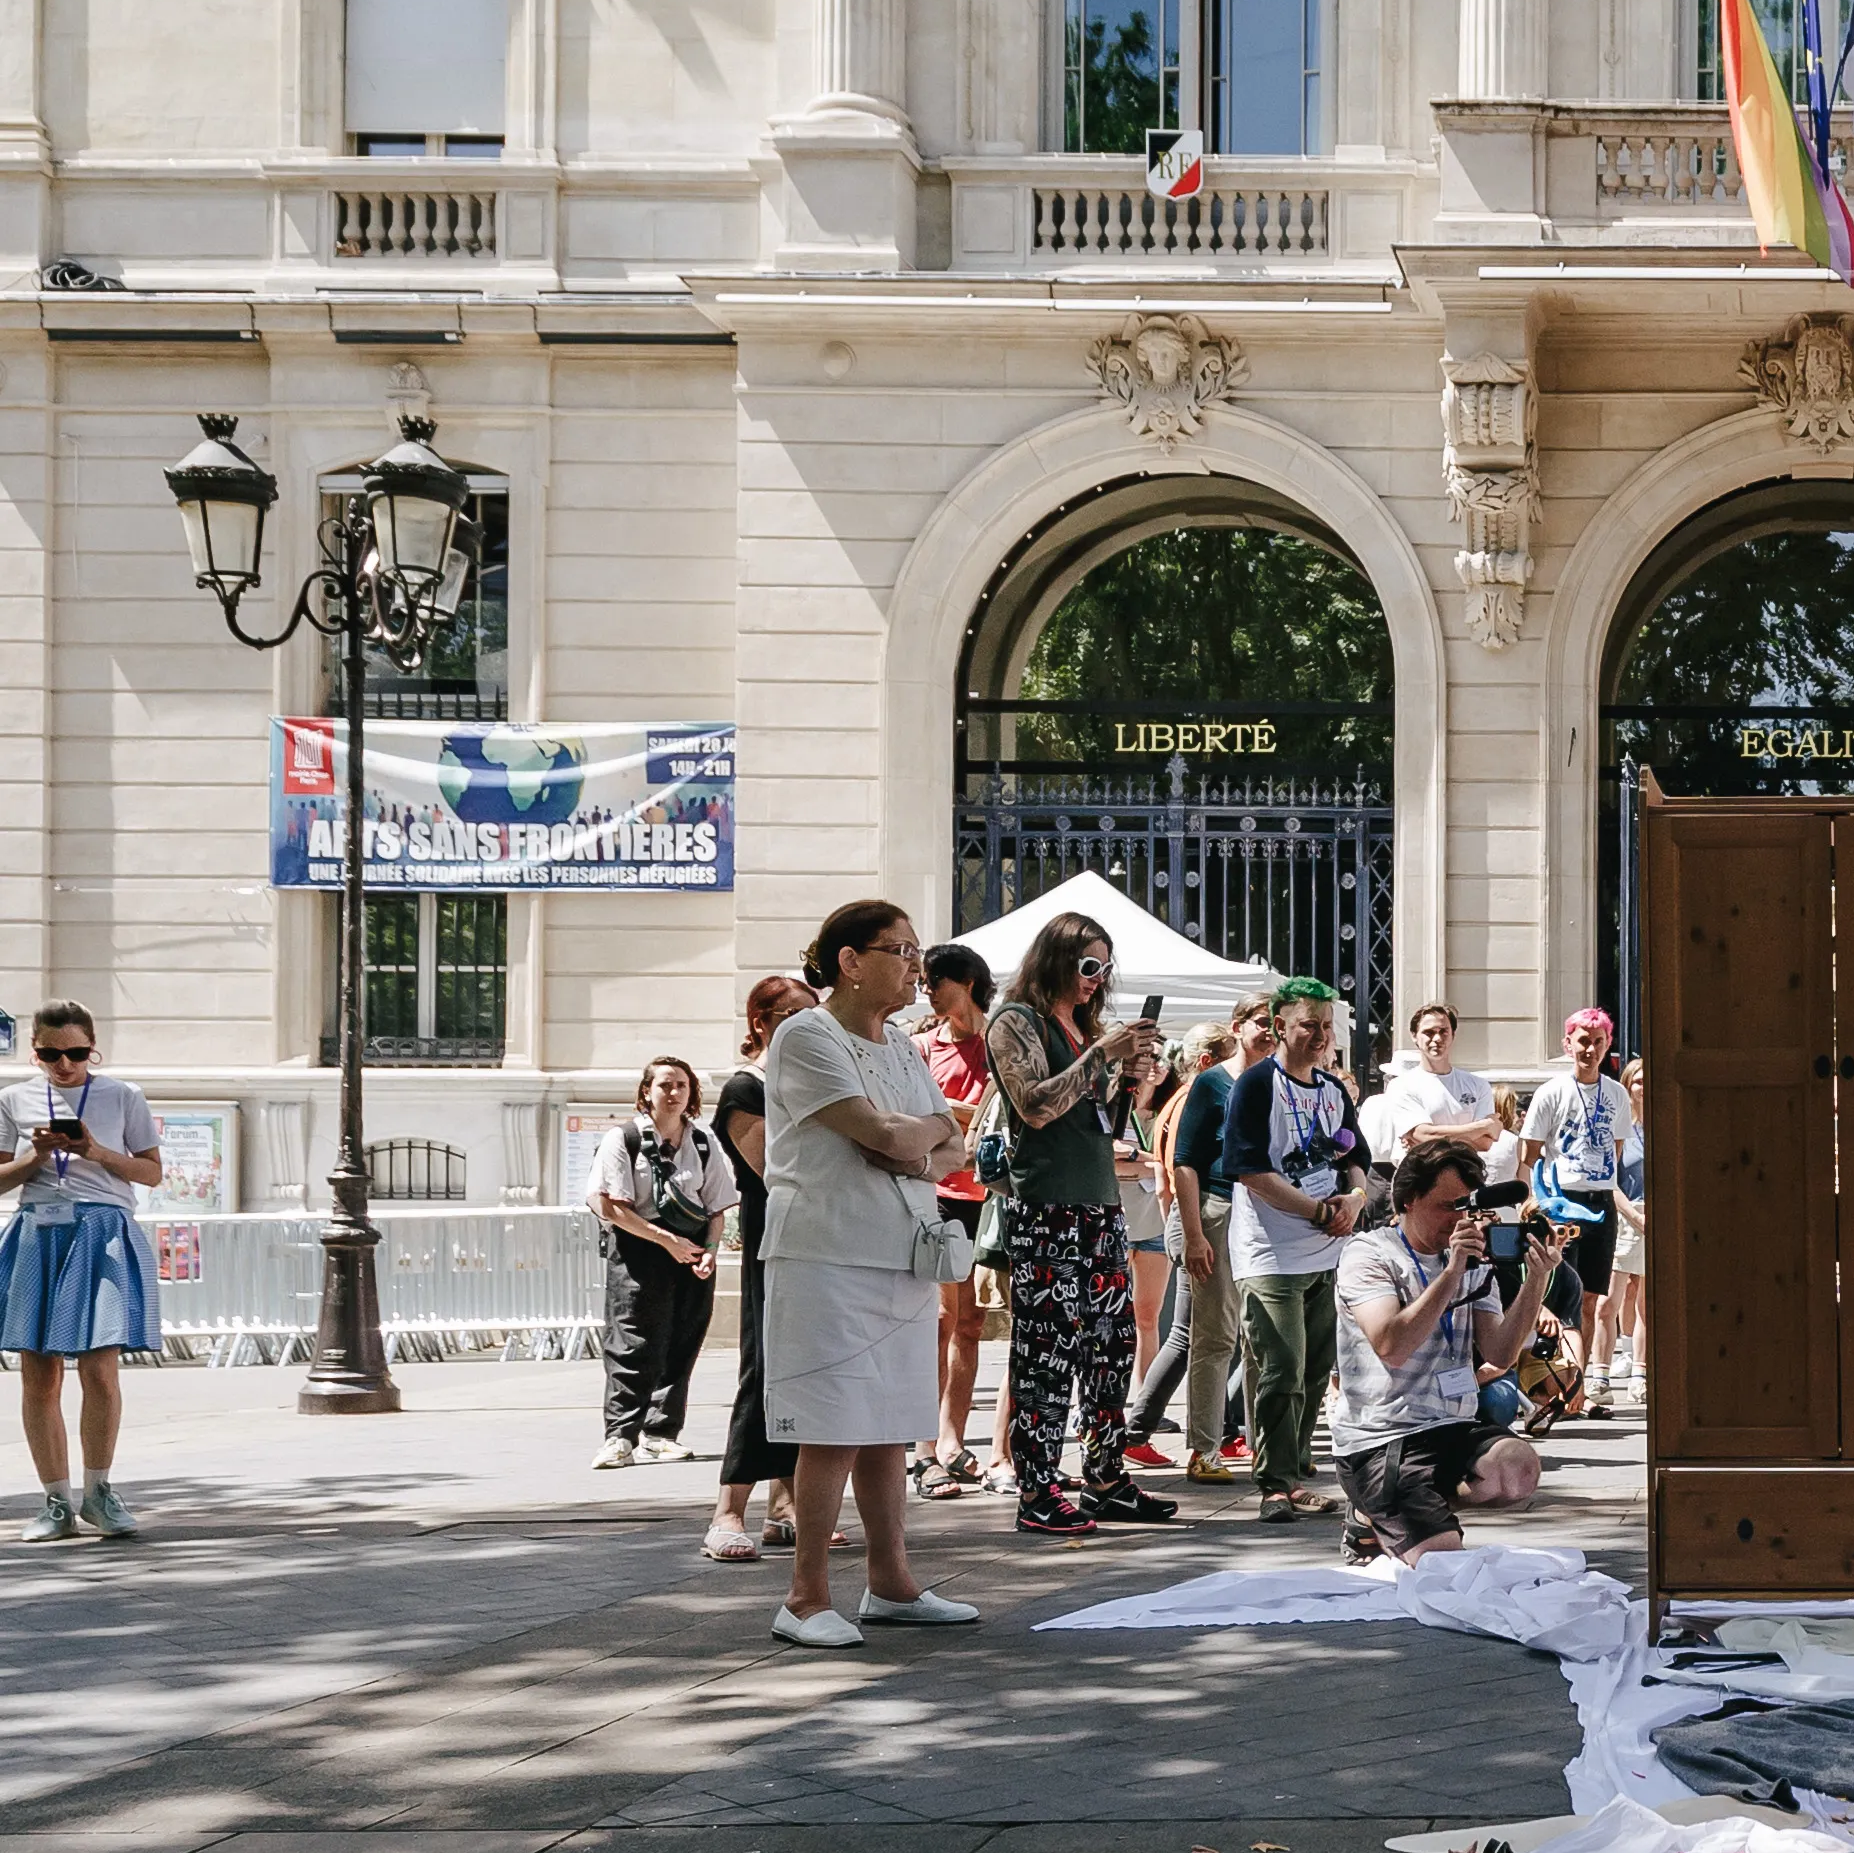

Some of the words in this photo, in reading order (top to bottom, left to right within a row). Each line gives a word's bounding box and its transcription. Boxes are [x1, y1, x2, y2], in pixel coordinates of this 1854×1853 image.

[1156, 150, 1193, 181] RF
[1114, 718, 1277, 753] LIBERTÉ
[668, 759, 696, 777] 14H
[704, 759, 731, 777] 21H
[408, 822, 502, 862] SANS
[508, 819, 718, 863] FRONTIÈRES
[308, 863, 339, 881] UNE
[404, 863, 483, 884] SOLIDAIRE
[483, 864, 522, 884] AVEC
[524, 864, 549, 884] LES
[551, 865, 638, 884] PERSONNES
[639, 863, 718, 885] RÉFUGIÉES
